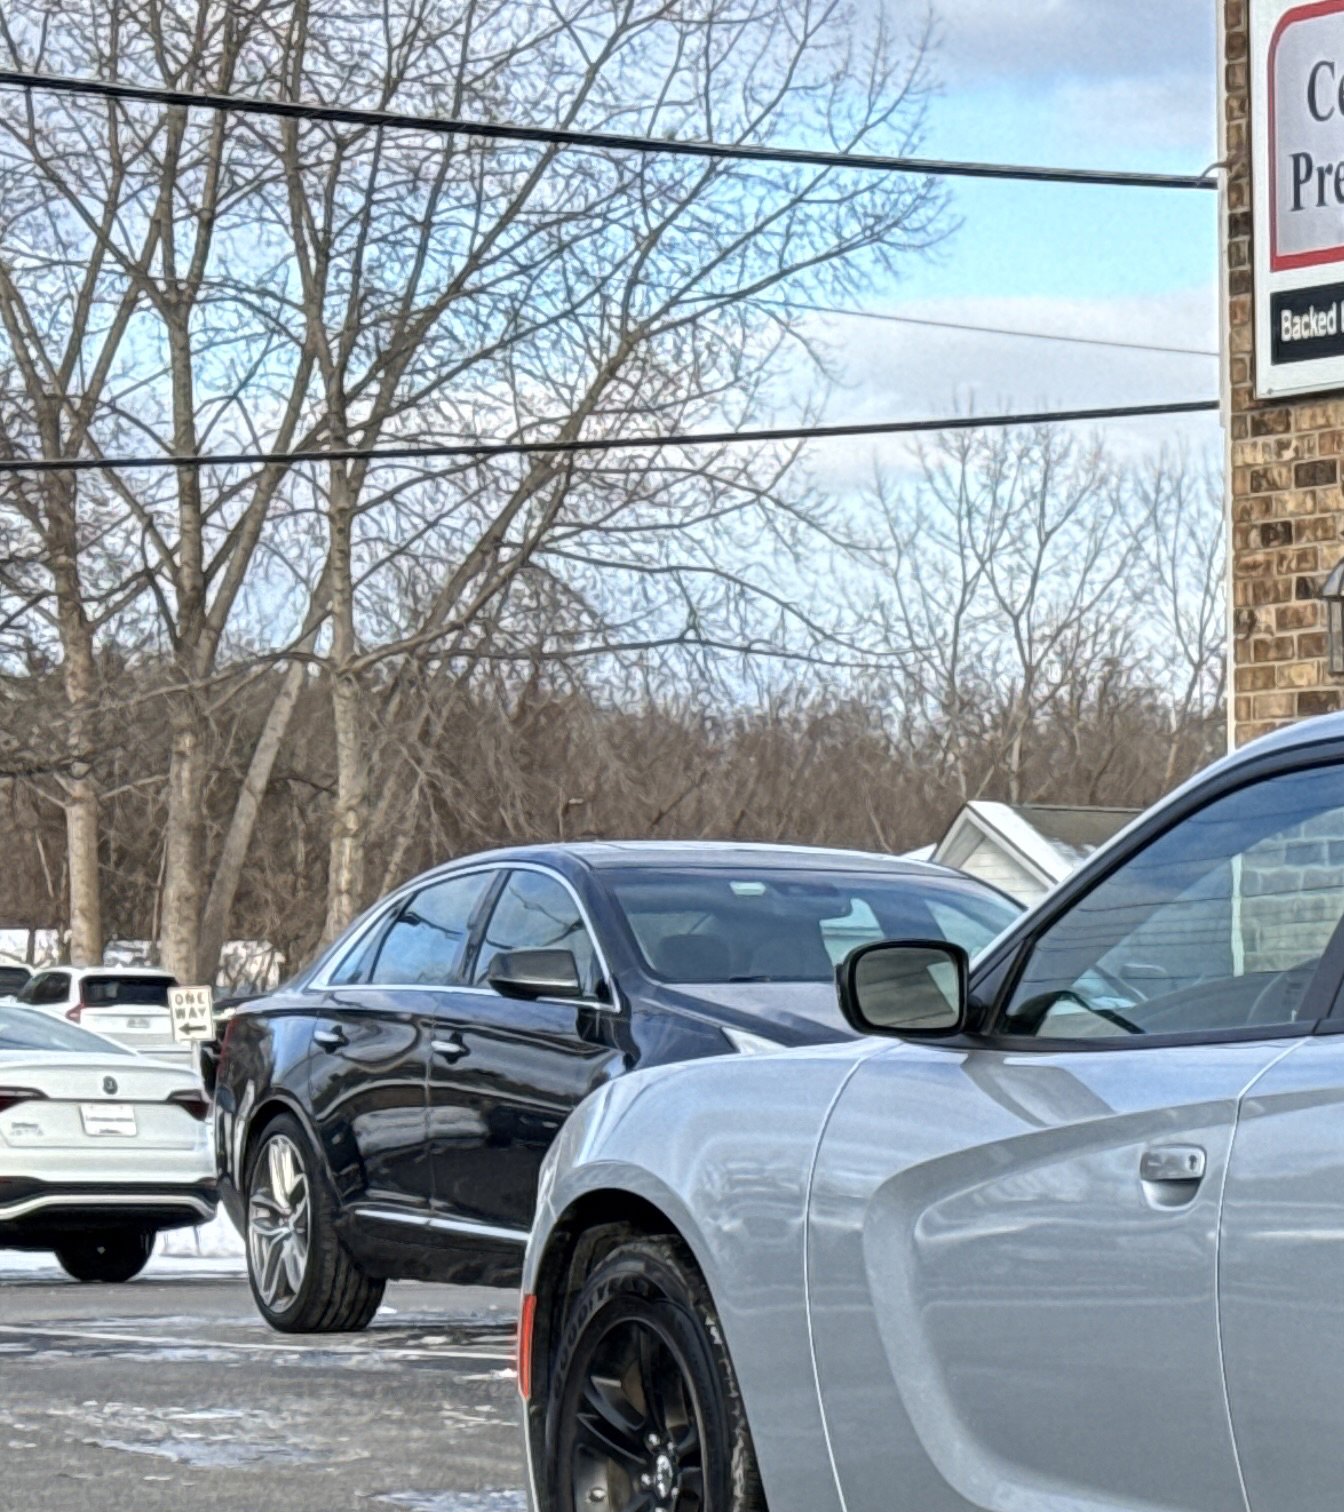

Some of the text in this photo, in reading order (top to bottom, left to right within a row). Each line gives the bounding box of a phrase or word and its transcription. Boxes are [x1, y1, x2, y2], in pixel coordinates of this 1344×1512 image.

[1280, 302, 1338, 342] Backed
[174, 991, 205, 1006] ONE
[174, 1007, 207, 1020] WAY
